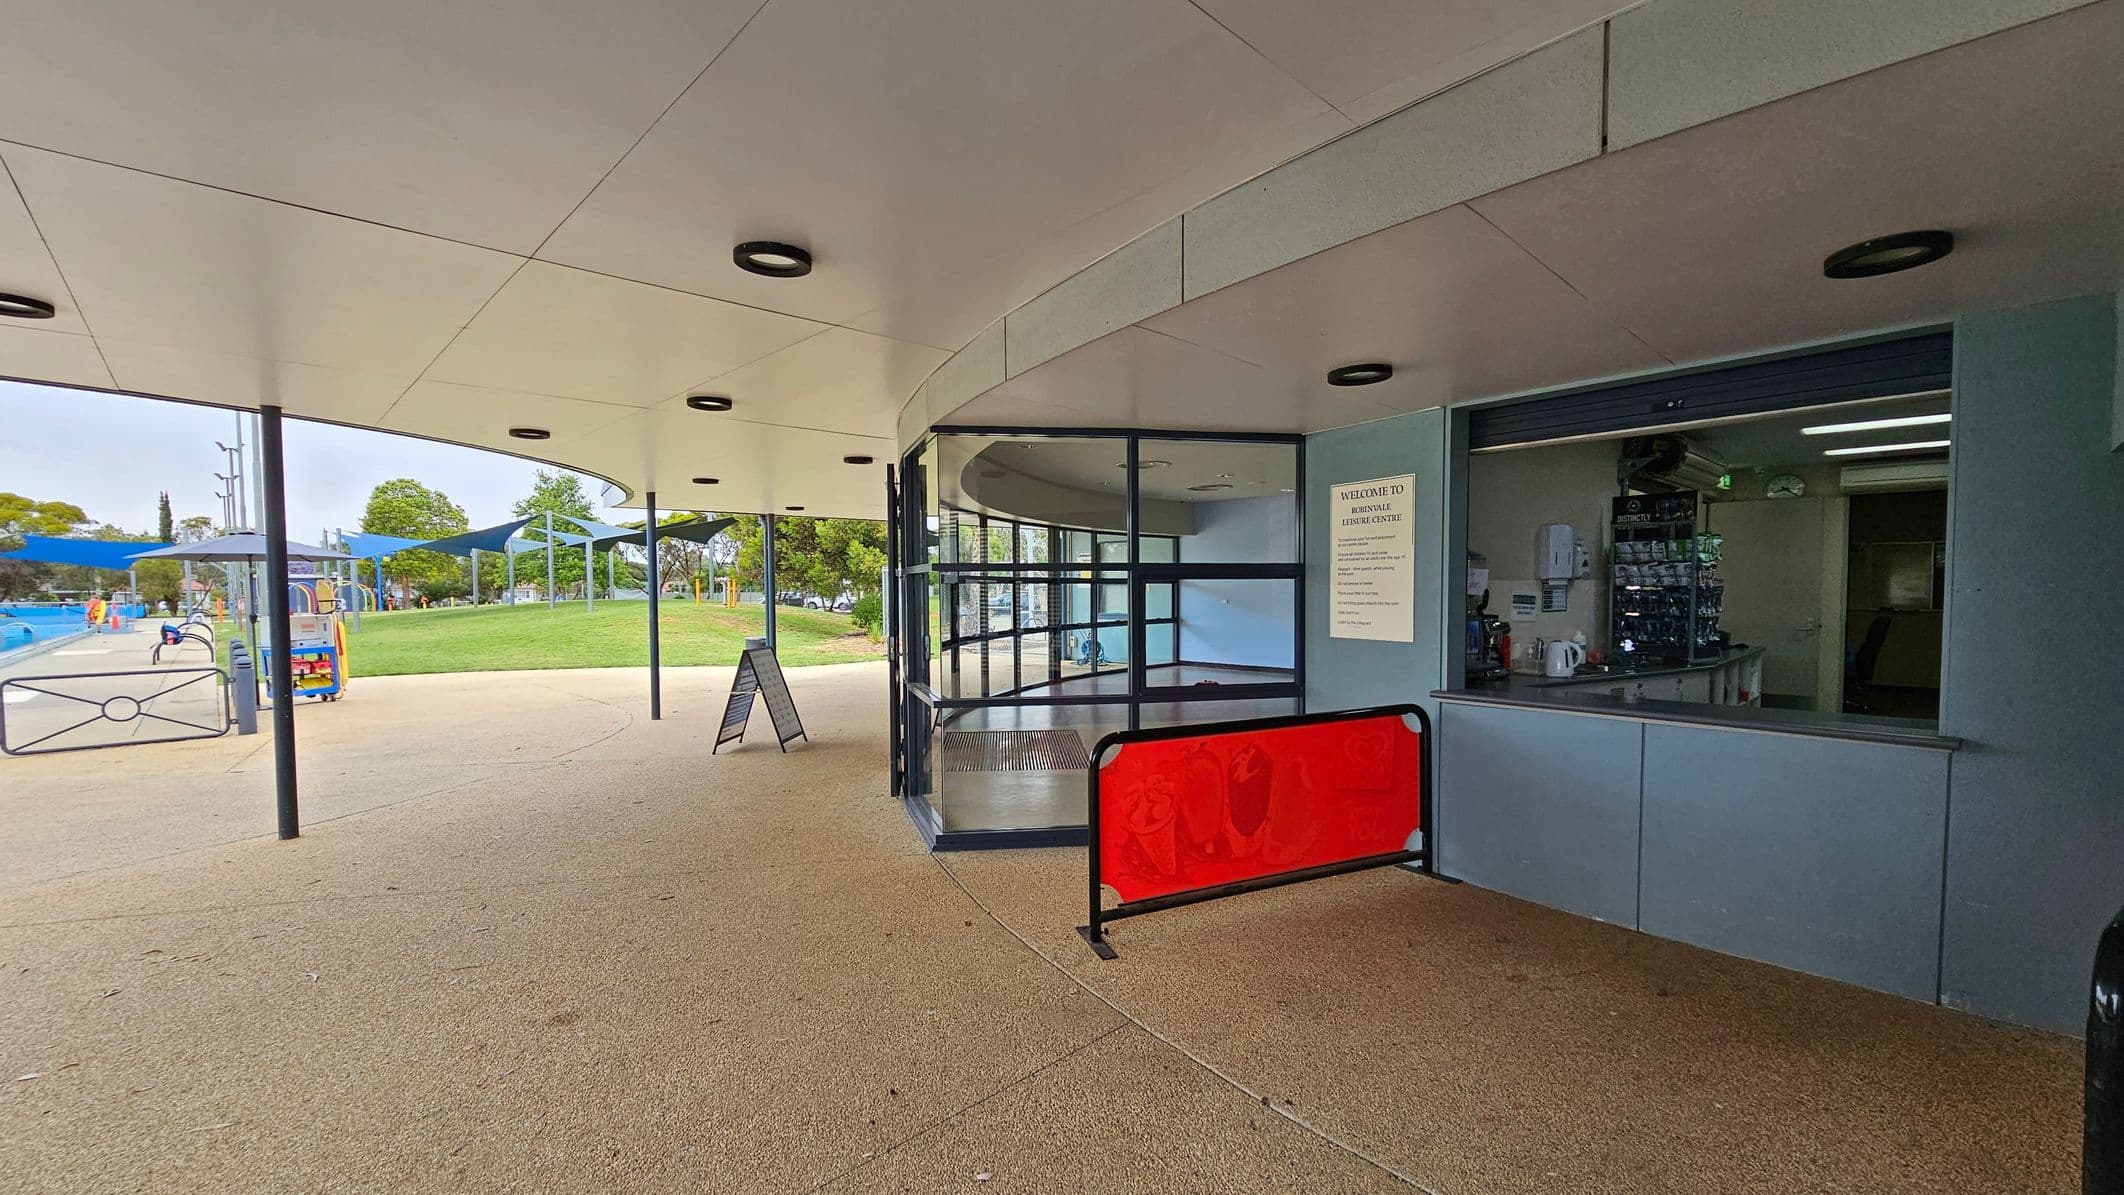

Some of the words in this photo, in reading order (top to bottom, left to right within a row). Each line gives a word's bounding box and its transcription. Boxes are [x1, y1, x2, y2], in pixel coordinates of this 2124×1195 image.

[1341, 486, 1388, 501] WELCOME
[1390, 485, 1404, 495] TO
[1351, 503, 1392, 514] ROBINVALE
[1342, 516, 1371, 526] LEISURE
[1372, 514, 1402, 523] CENTRE
[1617, 513, 1651, 522] DISTINCTLY
